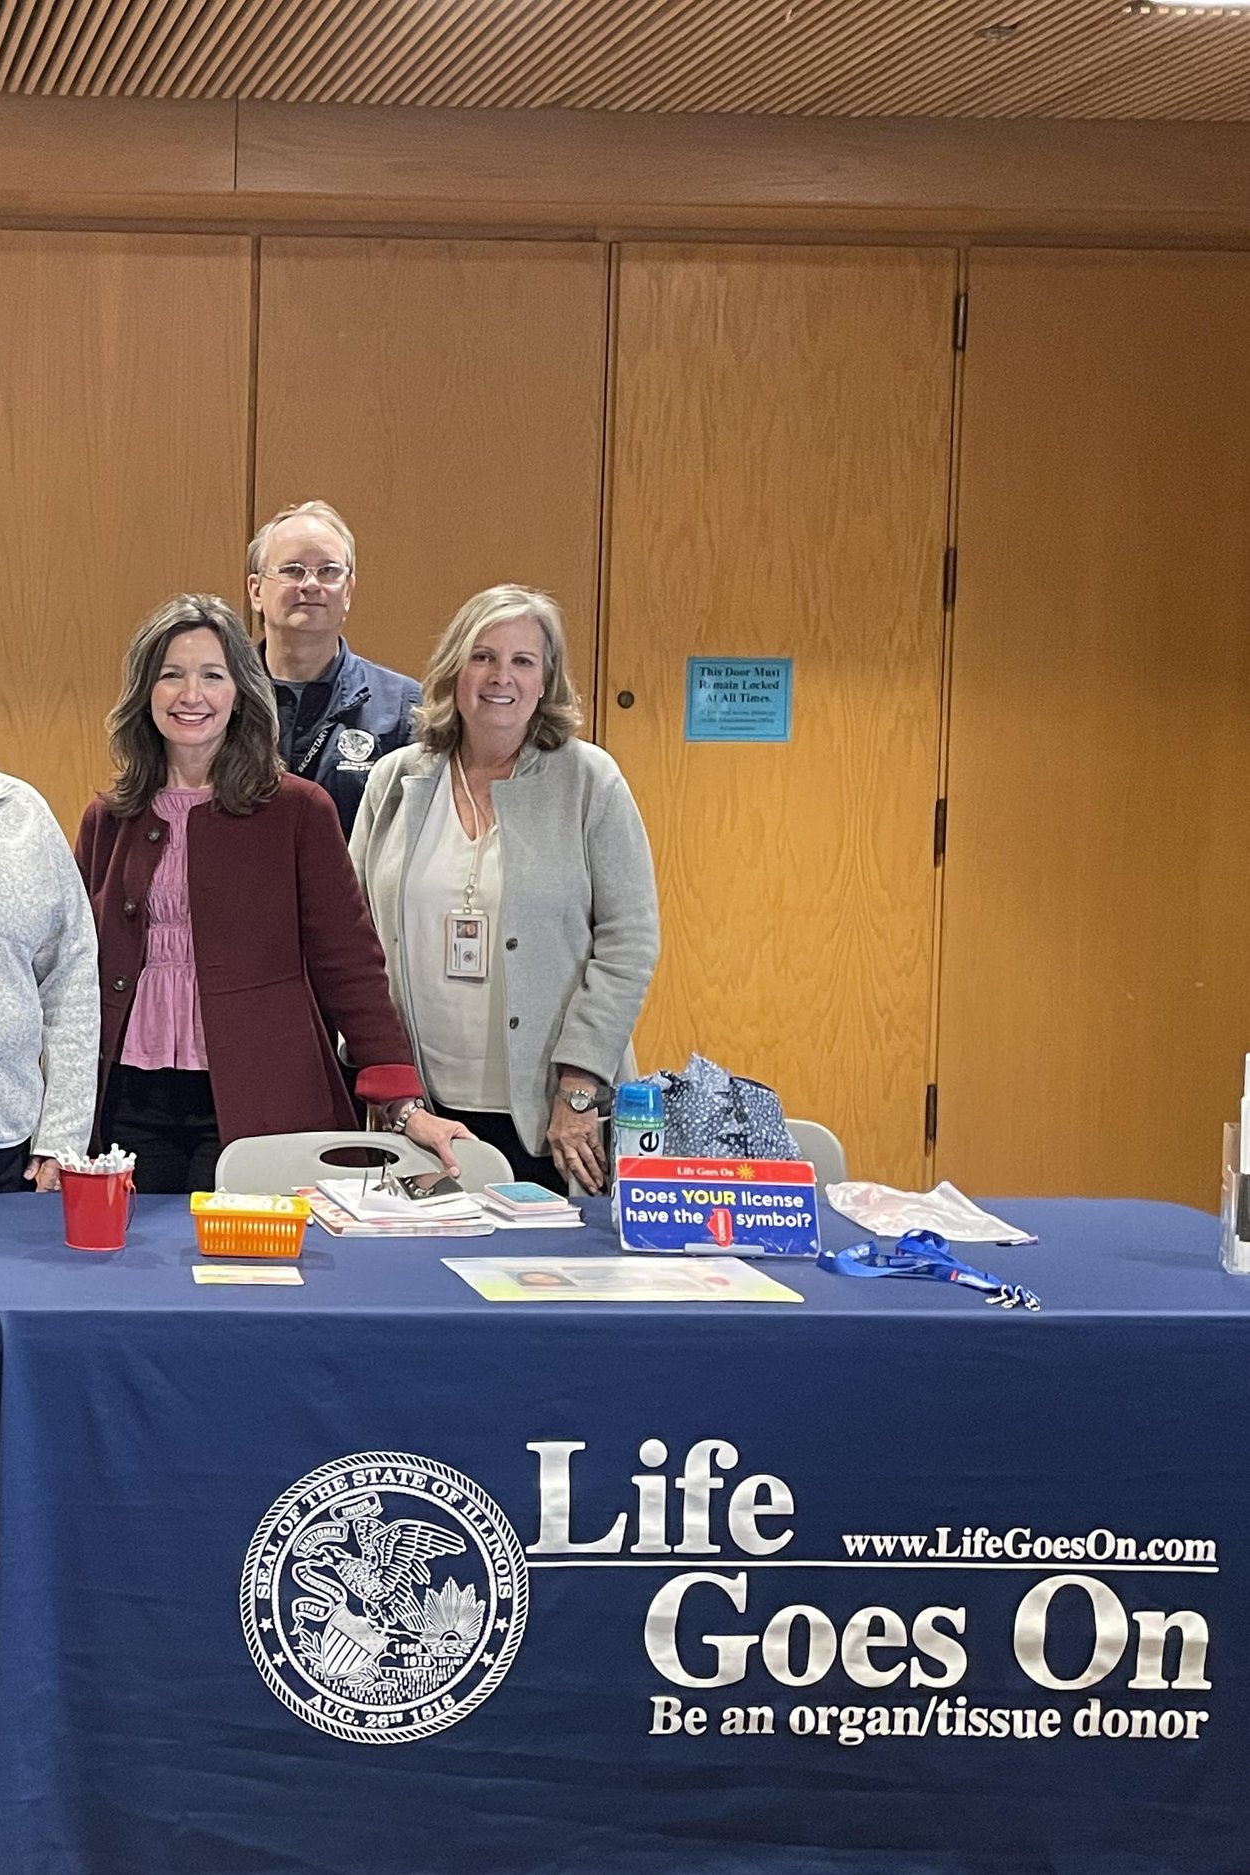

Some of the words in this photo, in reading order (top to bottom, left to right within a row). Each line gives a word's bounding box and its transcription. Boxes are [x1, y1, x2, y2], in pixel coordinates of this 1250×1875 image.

[700, 667, 722, 677] This
[725, 667, 750, 677] Door
[755, 667, 780, 677] Must
[742, 680, 780, 690] Locked
[722, 693, 736, 703] All
[720, 1168, 735, 1177] On
[631, 1188, 677, 1205] Does
[681, 1189, 737, 1206] YOUR
[741, 1190, 805, 1208] license
[626, 1207, 669, 1224] have
[673, 1208, 704, 1225] the
[736, 1211, 812, 1229] symbol?
[341, 1499, 371, 1516] UNION
[526, 1438, 795, 1555] Life
[256, 1534, 284, 1600] SEAL
[280, 1507, 302, 1537] OF
[302, 1475, 350, 1509] THE
[351, 1467, 428, 1491] STATE
[431, 1478, 463, 1504] OF
[460, 1499, 513, 1600] ILLINOIS
[298, 1527, 343, 1553] NATIONAL
[841, 1526, 1218, 1563] www.LifeGoesOn.com
[643, 1571, 968, 1688] Goes
[1013, 1574, 1213, 1691] On
[305, 1693, 360, 1726] AUG.
[410, 1693, 456, 1725] 1818
[648, 1696, 708, 1736] Be
[720, 1705, 776, 1736] an
[787, 1695, 1063, 1746] organ/tissue
[1072, 1698, 1210, 1740] donor
